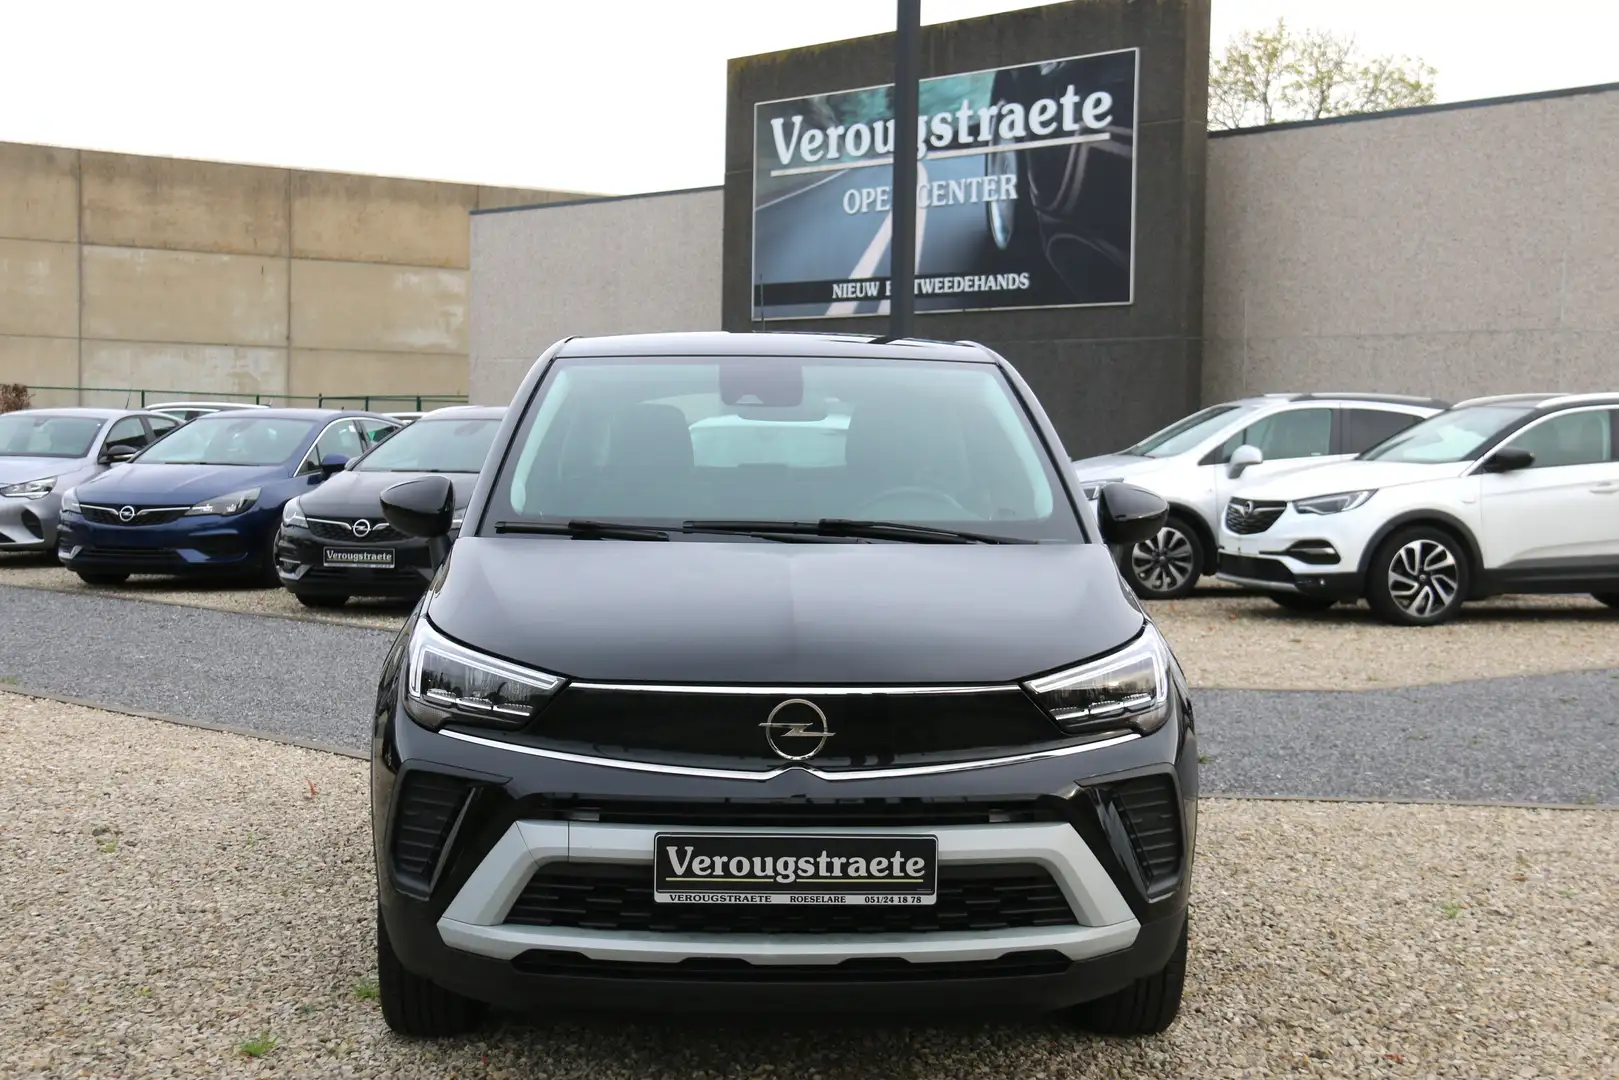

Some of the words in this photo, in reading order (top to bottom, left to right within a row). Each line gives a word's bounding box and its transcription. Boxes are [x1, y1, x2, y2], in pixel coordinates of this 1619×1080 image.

[843, 186, 893, 214] OPE
[917, 174, 1018, 209] CENTER
[832, 282, 880, 299] NIEUW
[326, 549, 392, 562] Verougstraete
[666, 846, 925, 883] Verougstraete
[669, 894, 772, 903] VEROUGSTRAETE
[789, 895, 847, 904] ROESELARE
[864, 896, 894, 904] 051/24
[897, 896, 908, 904] 18
[910, 896, 922, 904] 78
